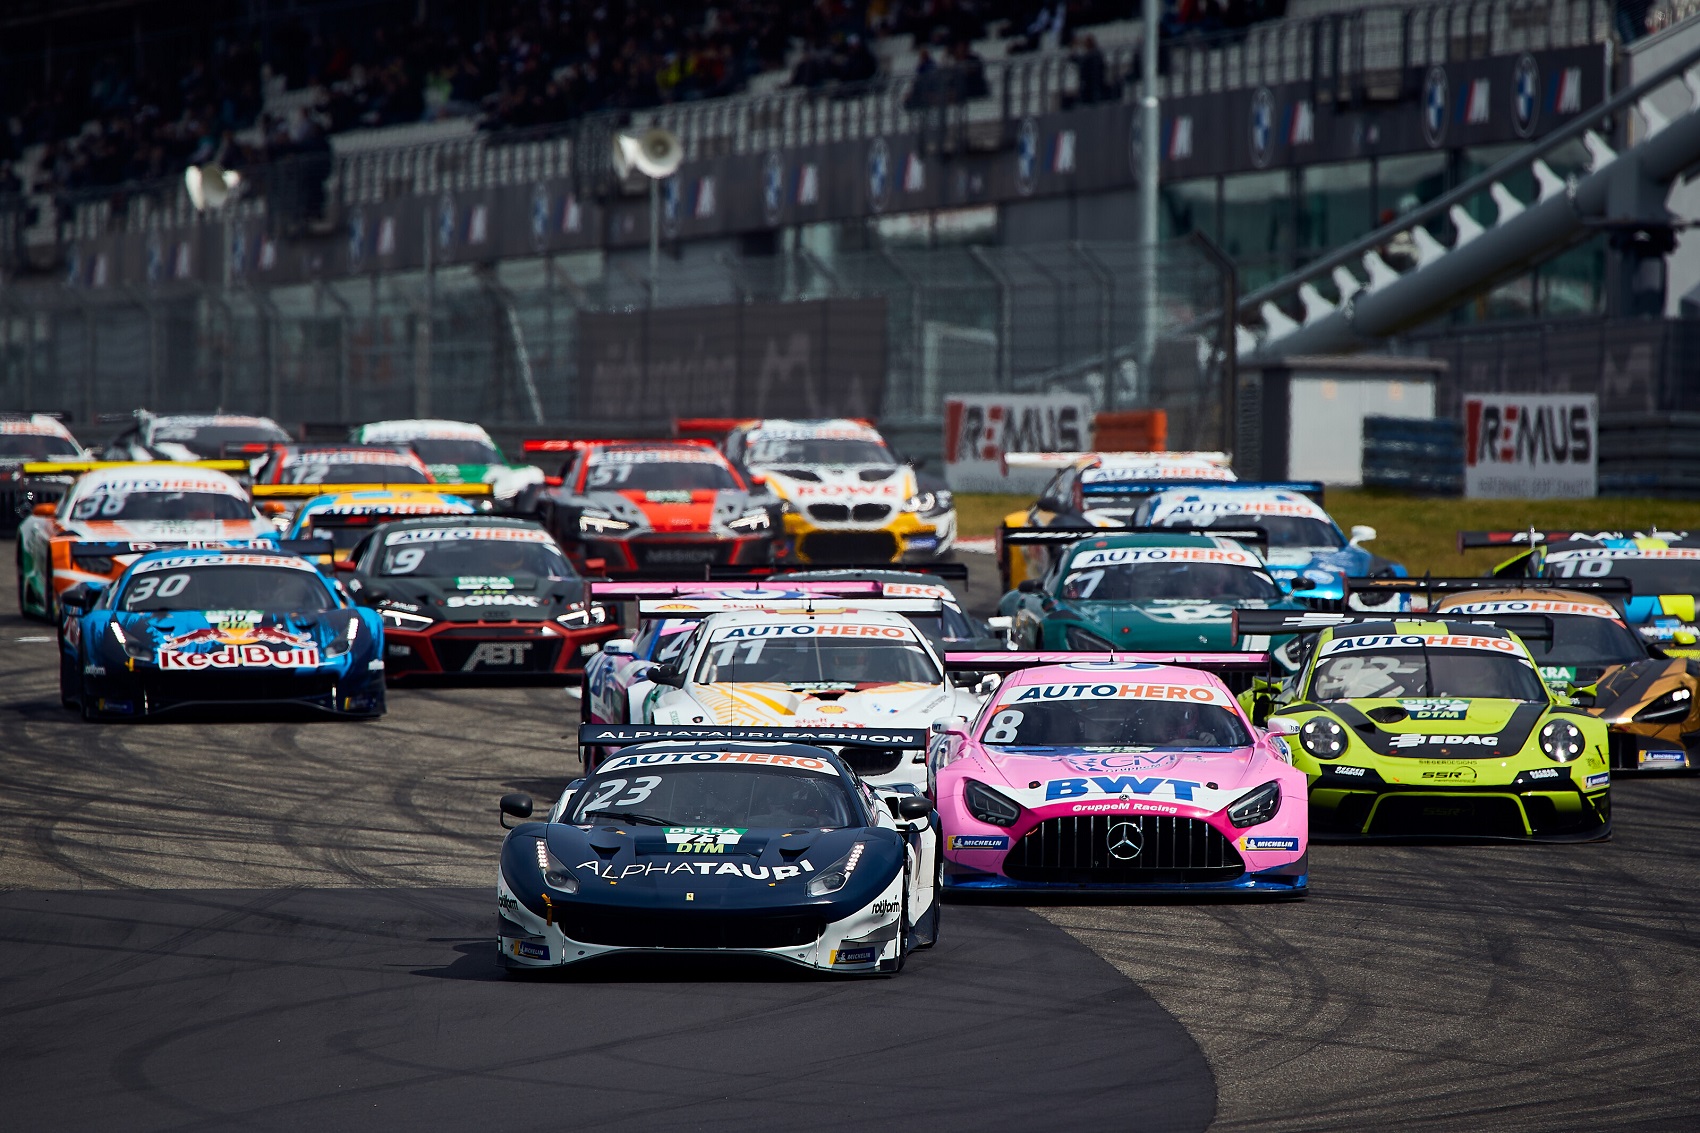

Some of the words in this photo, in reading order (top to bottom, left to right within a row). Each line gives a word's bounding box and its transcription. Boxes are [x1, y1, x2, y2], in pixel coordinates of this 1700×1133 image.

[961, 404, 1083, 461] REMUS
[1480, 404, 1592, 466] REMUS
[1095, 467, 1226, 480] AUTOHERO
[96, 479, 228, 491] AUTOHERO
[797, 485, 897, 497] ROWE
[1170, 501, 1313, 516] AUTOHERO
[398, 528, 545, 543] AUTOHERO
[144, 552, 304, 569] AUTOHERO
[391, 549, 426, 575] 9
[1088, 548, 1247, 563] AUTOHERO
[1556, 560, 1614, 578] 10
[130, 574, 191, 602] 30
[447, 595, 540, 608] SONAX
[1449, 601, 1613, 616] AUTOHERO
[723, 624, 906, 640] AUTOHERO
[1332, 636, 1516, 651] AUTOHERO
[160, 646, 236, 669] Red
[243, 646, 317, 666] Bull
[461, 642, 533, 672] ABT
[711, 638, 767, 667] 11
[1538, 667, 1571, 679] KRA
[1016, 684, 1216, 702] AUTOHERO
[1416, 710, 1460, 719] DTM
[984, 710, 1025, 743] 8
[596, 730, 914, 743] ALPHATAURI.FASHION
[1429, 735, 1499, 746] EDAG
[611, 752, 825, 770] AUTOHERO
[1421, 771, 1463, 779] SSR
[582, 775, 663, 813] 23
[1045, 776, 1201, 802] BWT
[1072, 803, 1130, 813] GruppeM
[1133, 803, 1178, 814] Racing
[669, 827, 739, 835] DEKRA
[676, 843, 725, 854] DTM
[1256, 840, 1294, 848] MICHELIN
[575, 858, 815, 881] ALPHATAURI
[846, 952, 871, 961] MICHELIN
